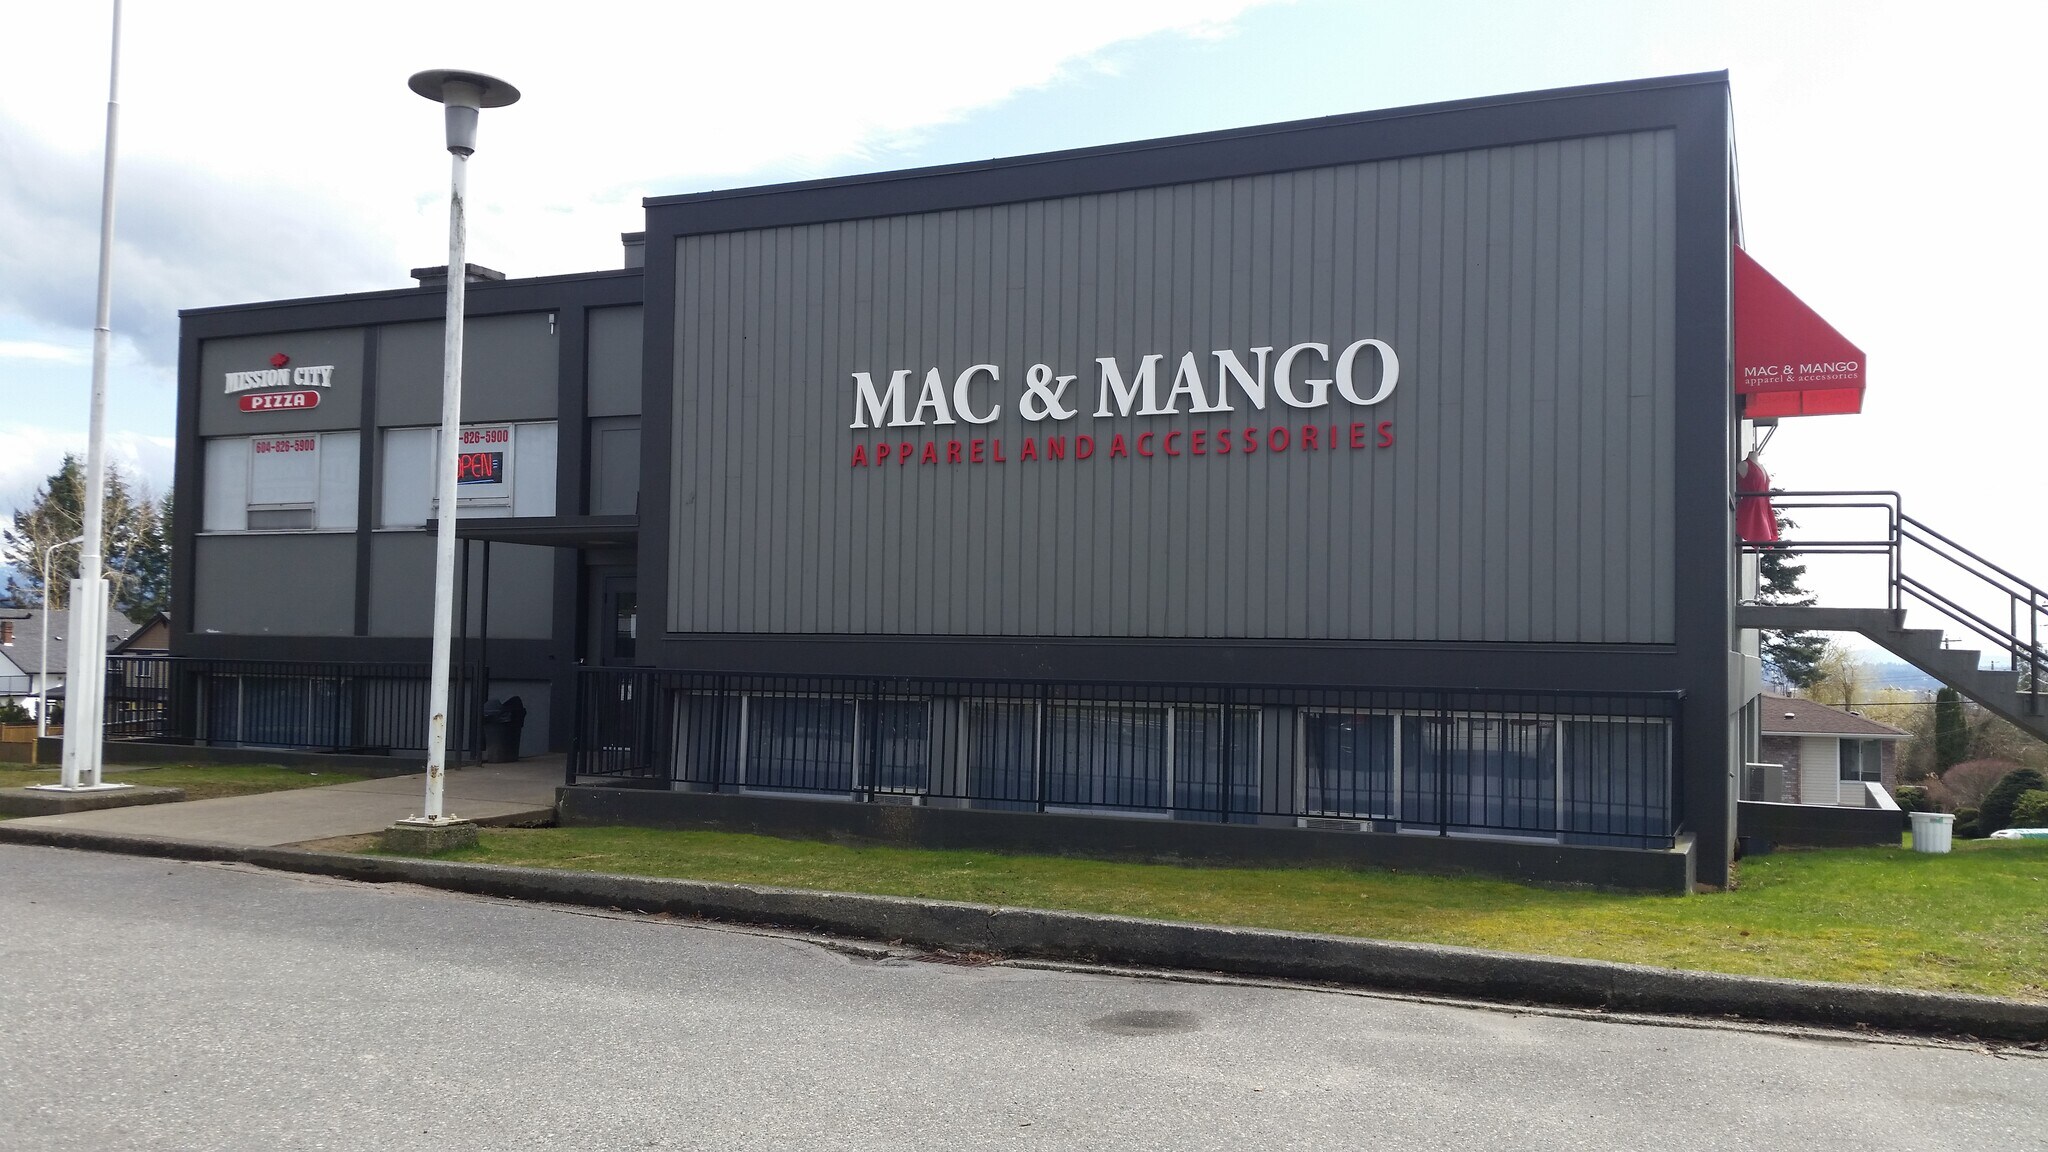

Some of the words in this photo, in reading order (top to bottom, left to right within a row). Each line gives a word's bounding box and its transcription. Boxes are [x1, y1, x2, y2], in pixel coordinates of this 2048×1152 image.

[1744, 366, 1778, 377] MAC
[1783, 364, 1794, 375] &
[1800, 361, 1858, 374] MANGO
[224, 369, 291, 394] MISSION
[294, 365, 335, 388] CITY
[850, 364, 1001, 429] MAC
[1019, 363, 1078, 421] &
[1093, 338, 1400, 417] MANGO
[1745, 375, 1783, 386] apparel
[1798, 372, 1858, 382] accessories
[251, 393, 305, 409] PIZZA
[459, 430, 509, 444] -826-5900
[852, 439, 1006, 467] APPAREL
[1021, 435, 1095, 461] AND
[1110, 421, 1393, 458] ACCESSORIES
[256, 439, 315, 453] 604-826-5900
